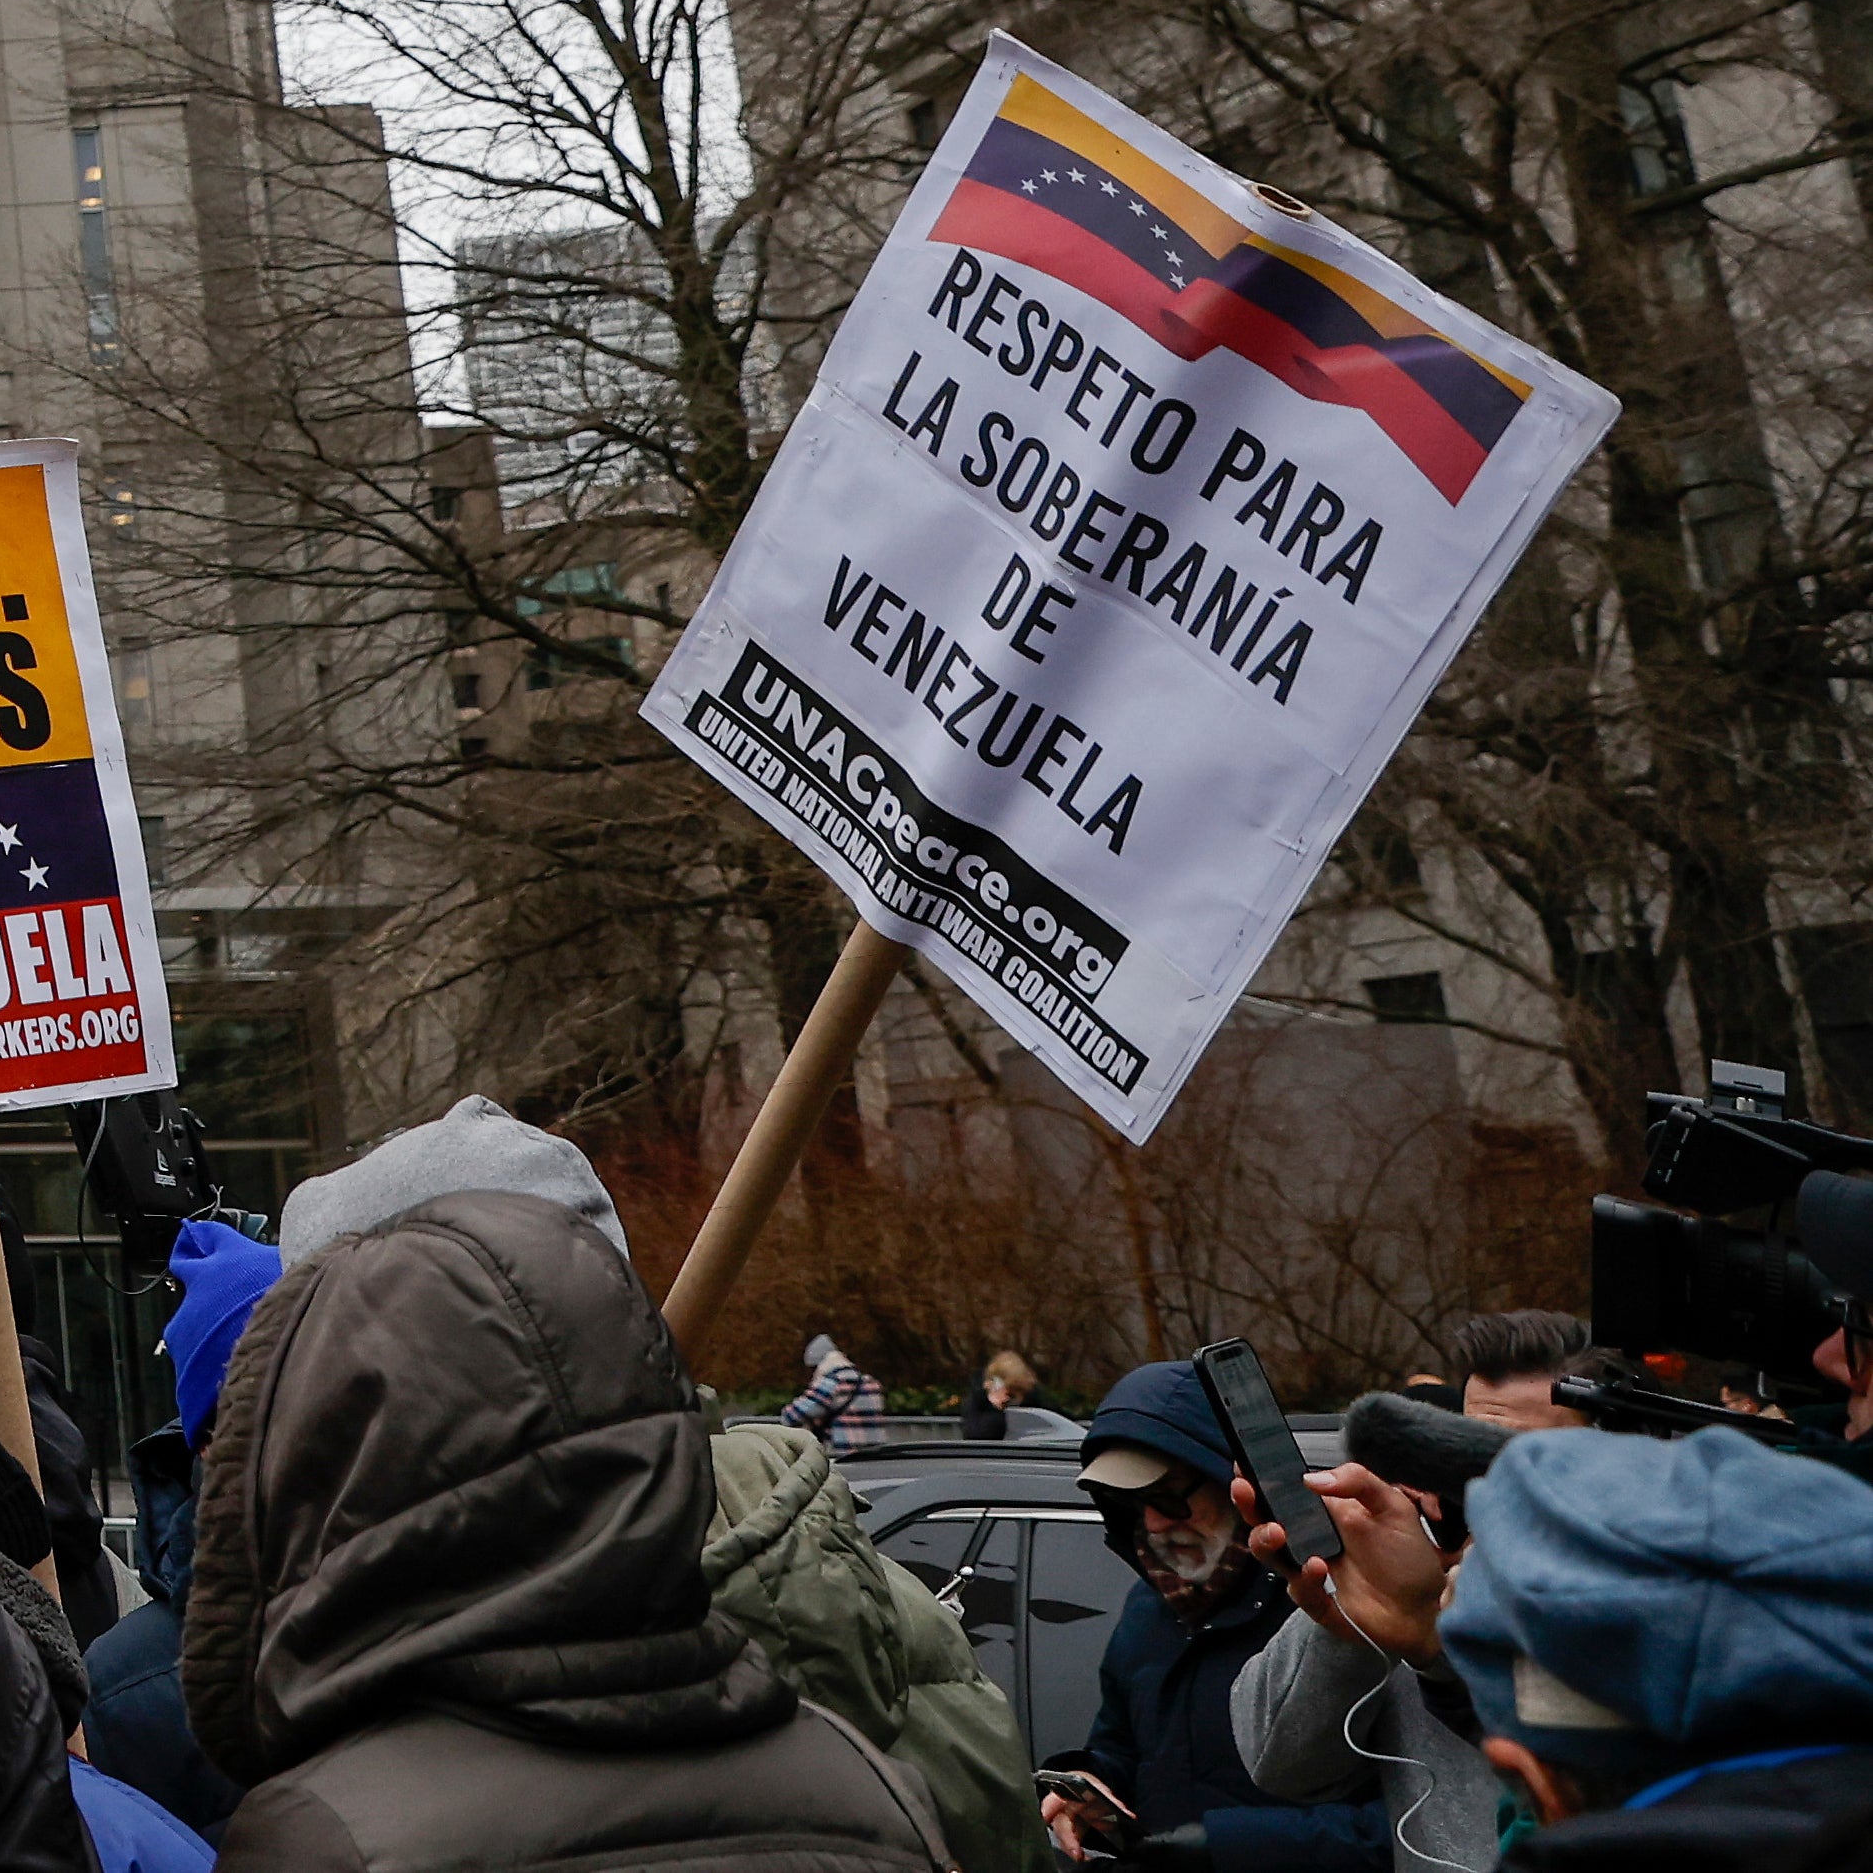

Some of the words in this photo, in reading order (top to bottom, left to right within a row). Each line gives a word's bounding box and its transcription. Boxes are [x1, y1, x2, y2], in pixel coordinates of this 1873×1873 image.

[881, 350, 961, 459] LA
[959, 411, 1315, 707] SOBERANÍA
[926, 246, 1198, 476] RESPETO
[1198, 426, 1385, 606] PARA
[821, 553, 1145, 856] VENEZUELA
[980, 552, 1077, 665] DE
[697, 705, 783, 791] UNITED
[1001, 954, 1138, 1086] COALITION
[740, 661, 1115, 995] UNACpeace.org
